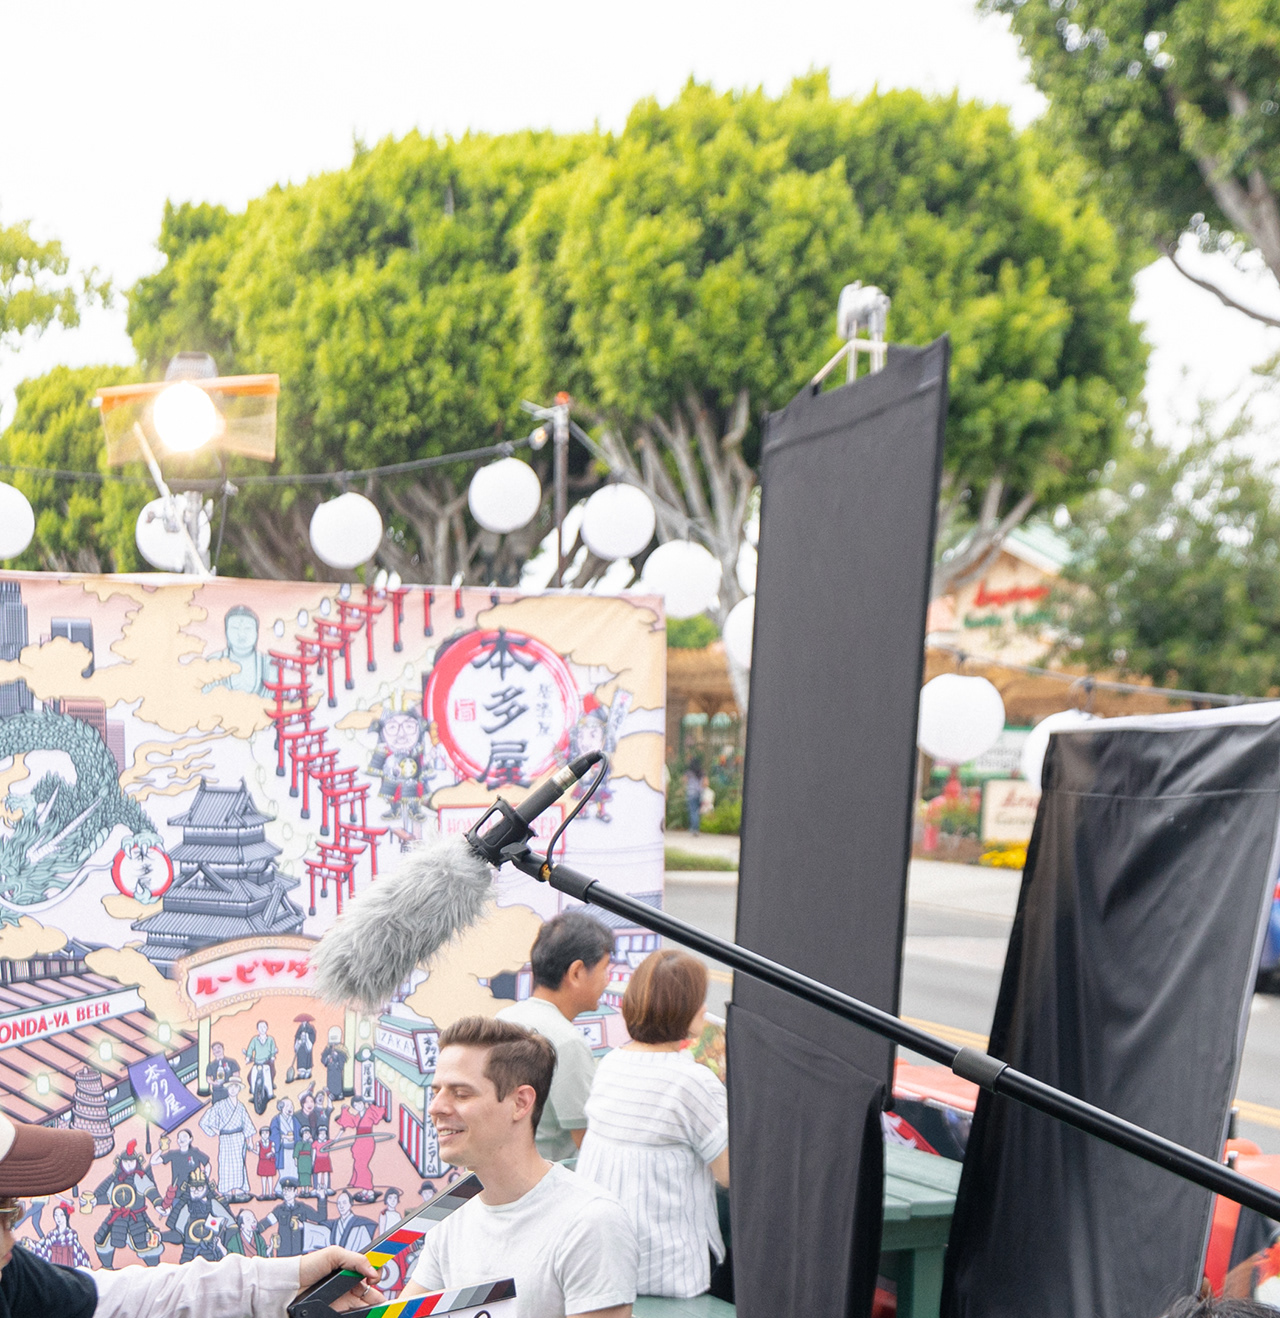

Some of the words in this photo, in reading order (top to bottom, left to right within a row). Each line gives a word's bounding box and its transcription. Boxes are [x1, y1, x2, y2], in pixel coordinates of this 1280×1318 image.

[471, 626, 539, 791] 本多屋
[76, 1001, 111, 1023] BEER
[377, 1030, 417, 1057] IZAKAY
[144, 1063, 186, 1118] 本多屋
